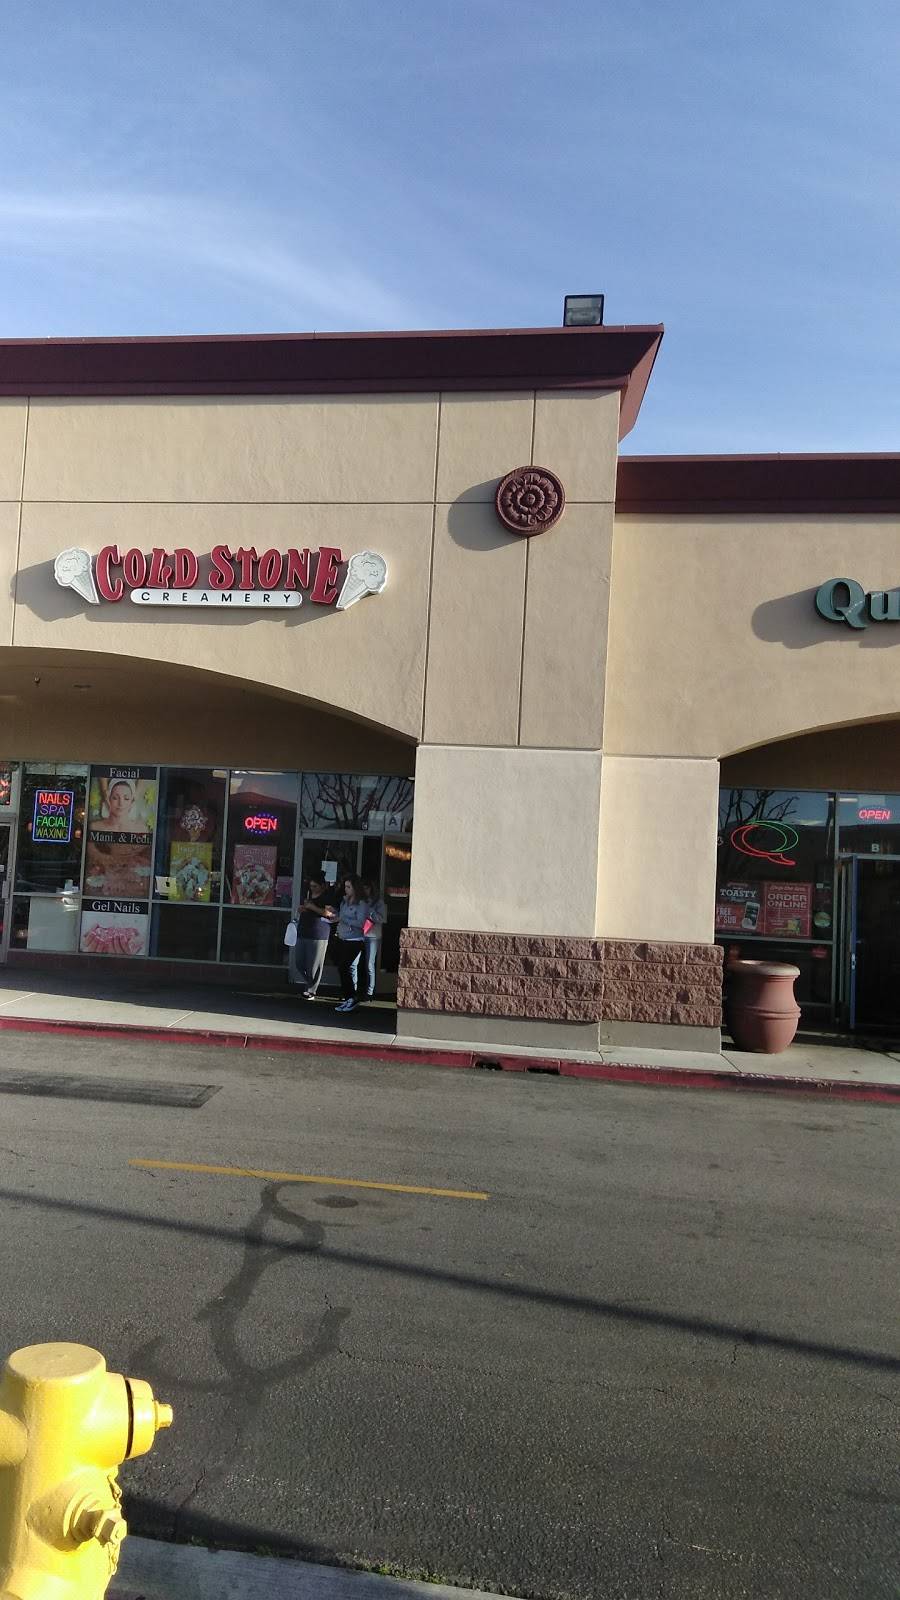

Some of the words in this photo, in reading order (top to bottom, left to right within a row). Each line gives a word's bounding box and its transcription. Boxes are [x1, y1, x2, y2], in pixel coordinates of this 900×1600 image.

[96, 544, 199, 601] COLD
[209, 544, 343, 604] STONE
[140, 590, 292, 604] CREAMERY
[108, 767, 141, 779] Facial
[38, 793, 71, 805] NAILS
[39, 804, 67, 816] SPA
[858, 809, 891, 821] OPEN
[36, 816, 69, 829] FACIAL
[244, 816, 278, 831] OPEN
[36, 828, 69, 840] WAXING
[720, 888, 757, 899] TOASTY
[767, 893, 807, 902] ORDER
[91, 901, 111, 912] Gel
[113, 902, 141, 914] Nails
[767, 901, 808, 910] ONLINE
